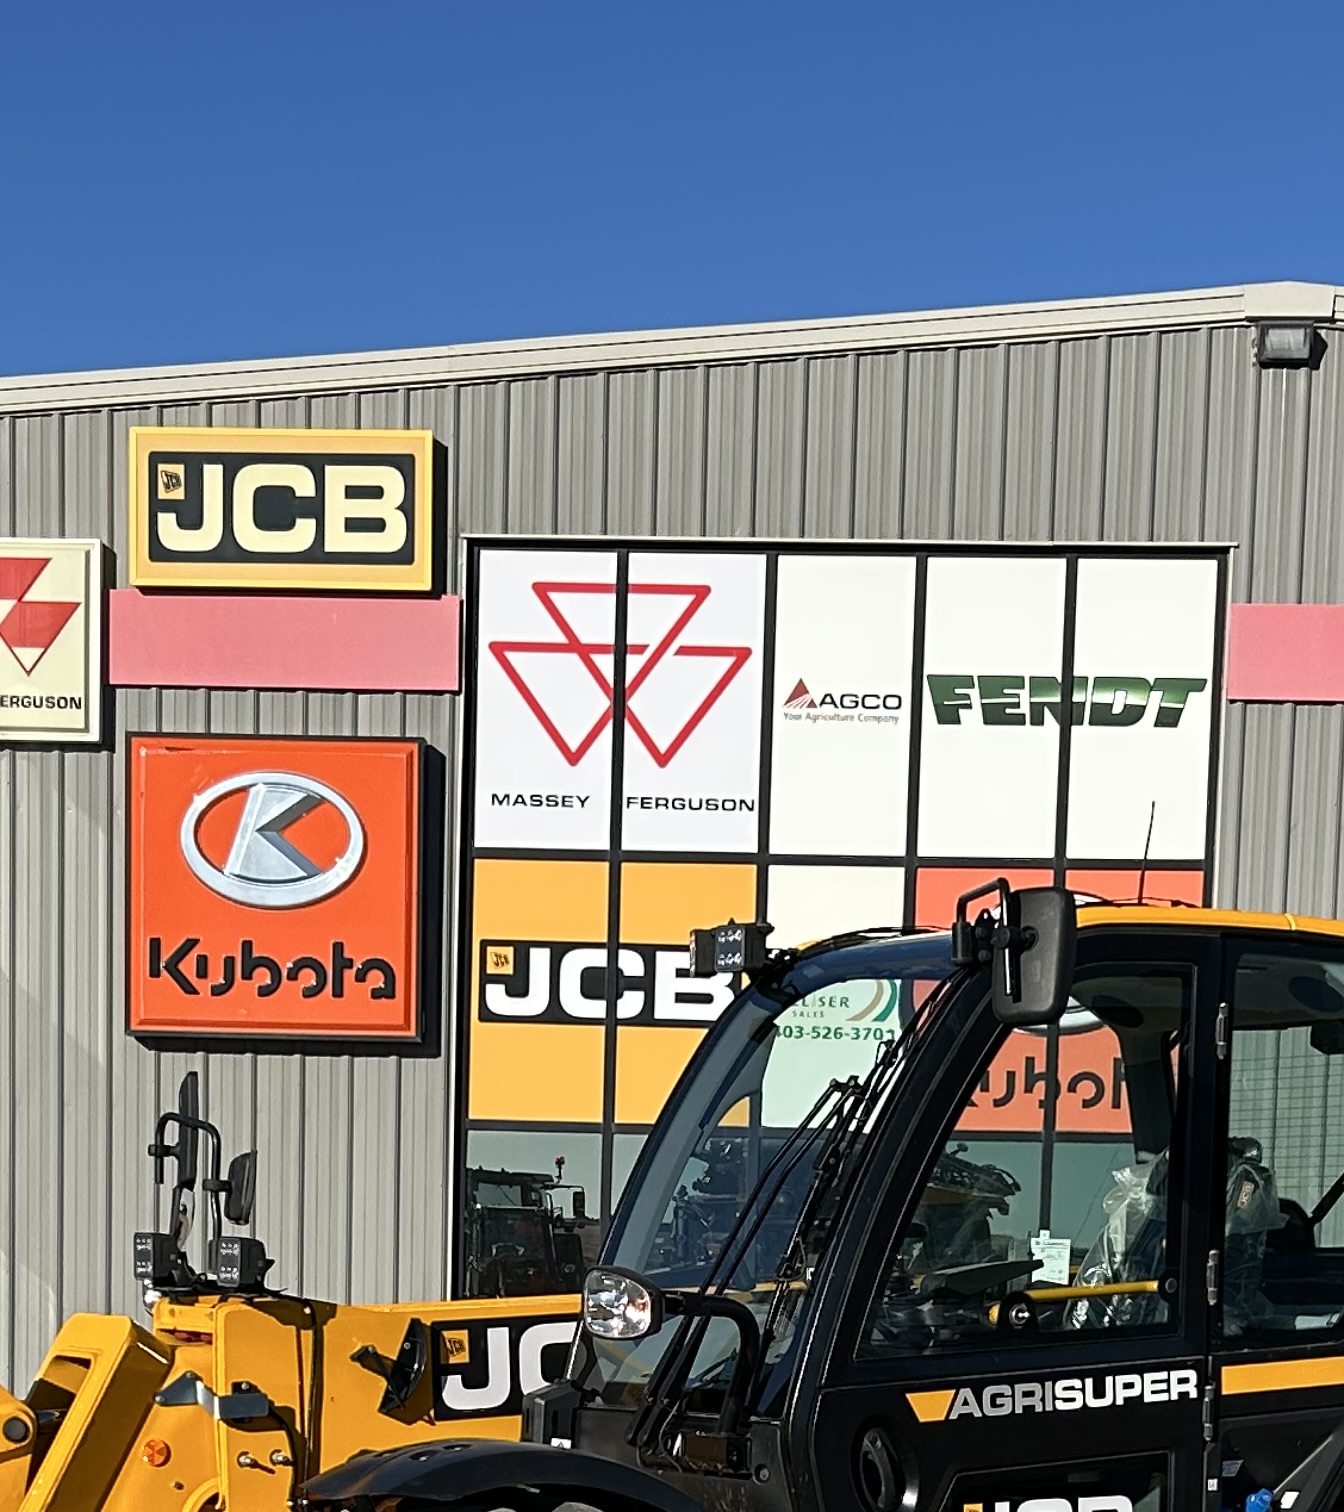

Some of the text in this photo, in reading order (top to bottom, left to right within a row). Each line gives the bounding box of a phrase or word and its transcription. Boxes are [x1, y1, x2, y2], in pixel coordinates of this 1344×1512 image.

[157, 464, 407, 552] JCB
[784, 712, 899, 725] Your Agriculture Company
[819, 693, 902, 710] AGCO
[926, 674, 1208, 728] FENDT
[491, 793, 755, 812] MASSEY FERGUSON
[148, 937, 396, 1000] Kubota
[485, 947, 736, 1021] JCB
[966, 1056, 1127, 1109] ubot
[441, 1321, 584, 1411] JC
[949, 1369, 1198, 1420] AGRISUPER
